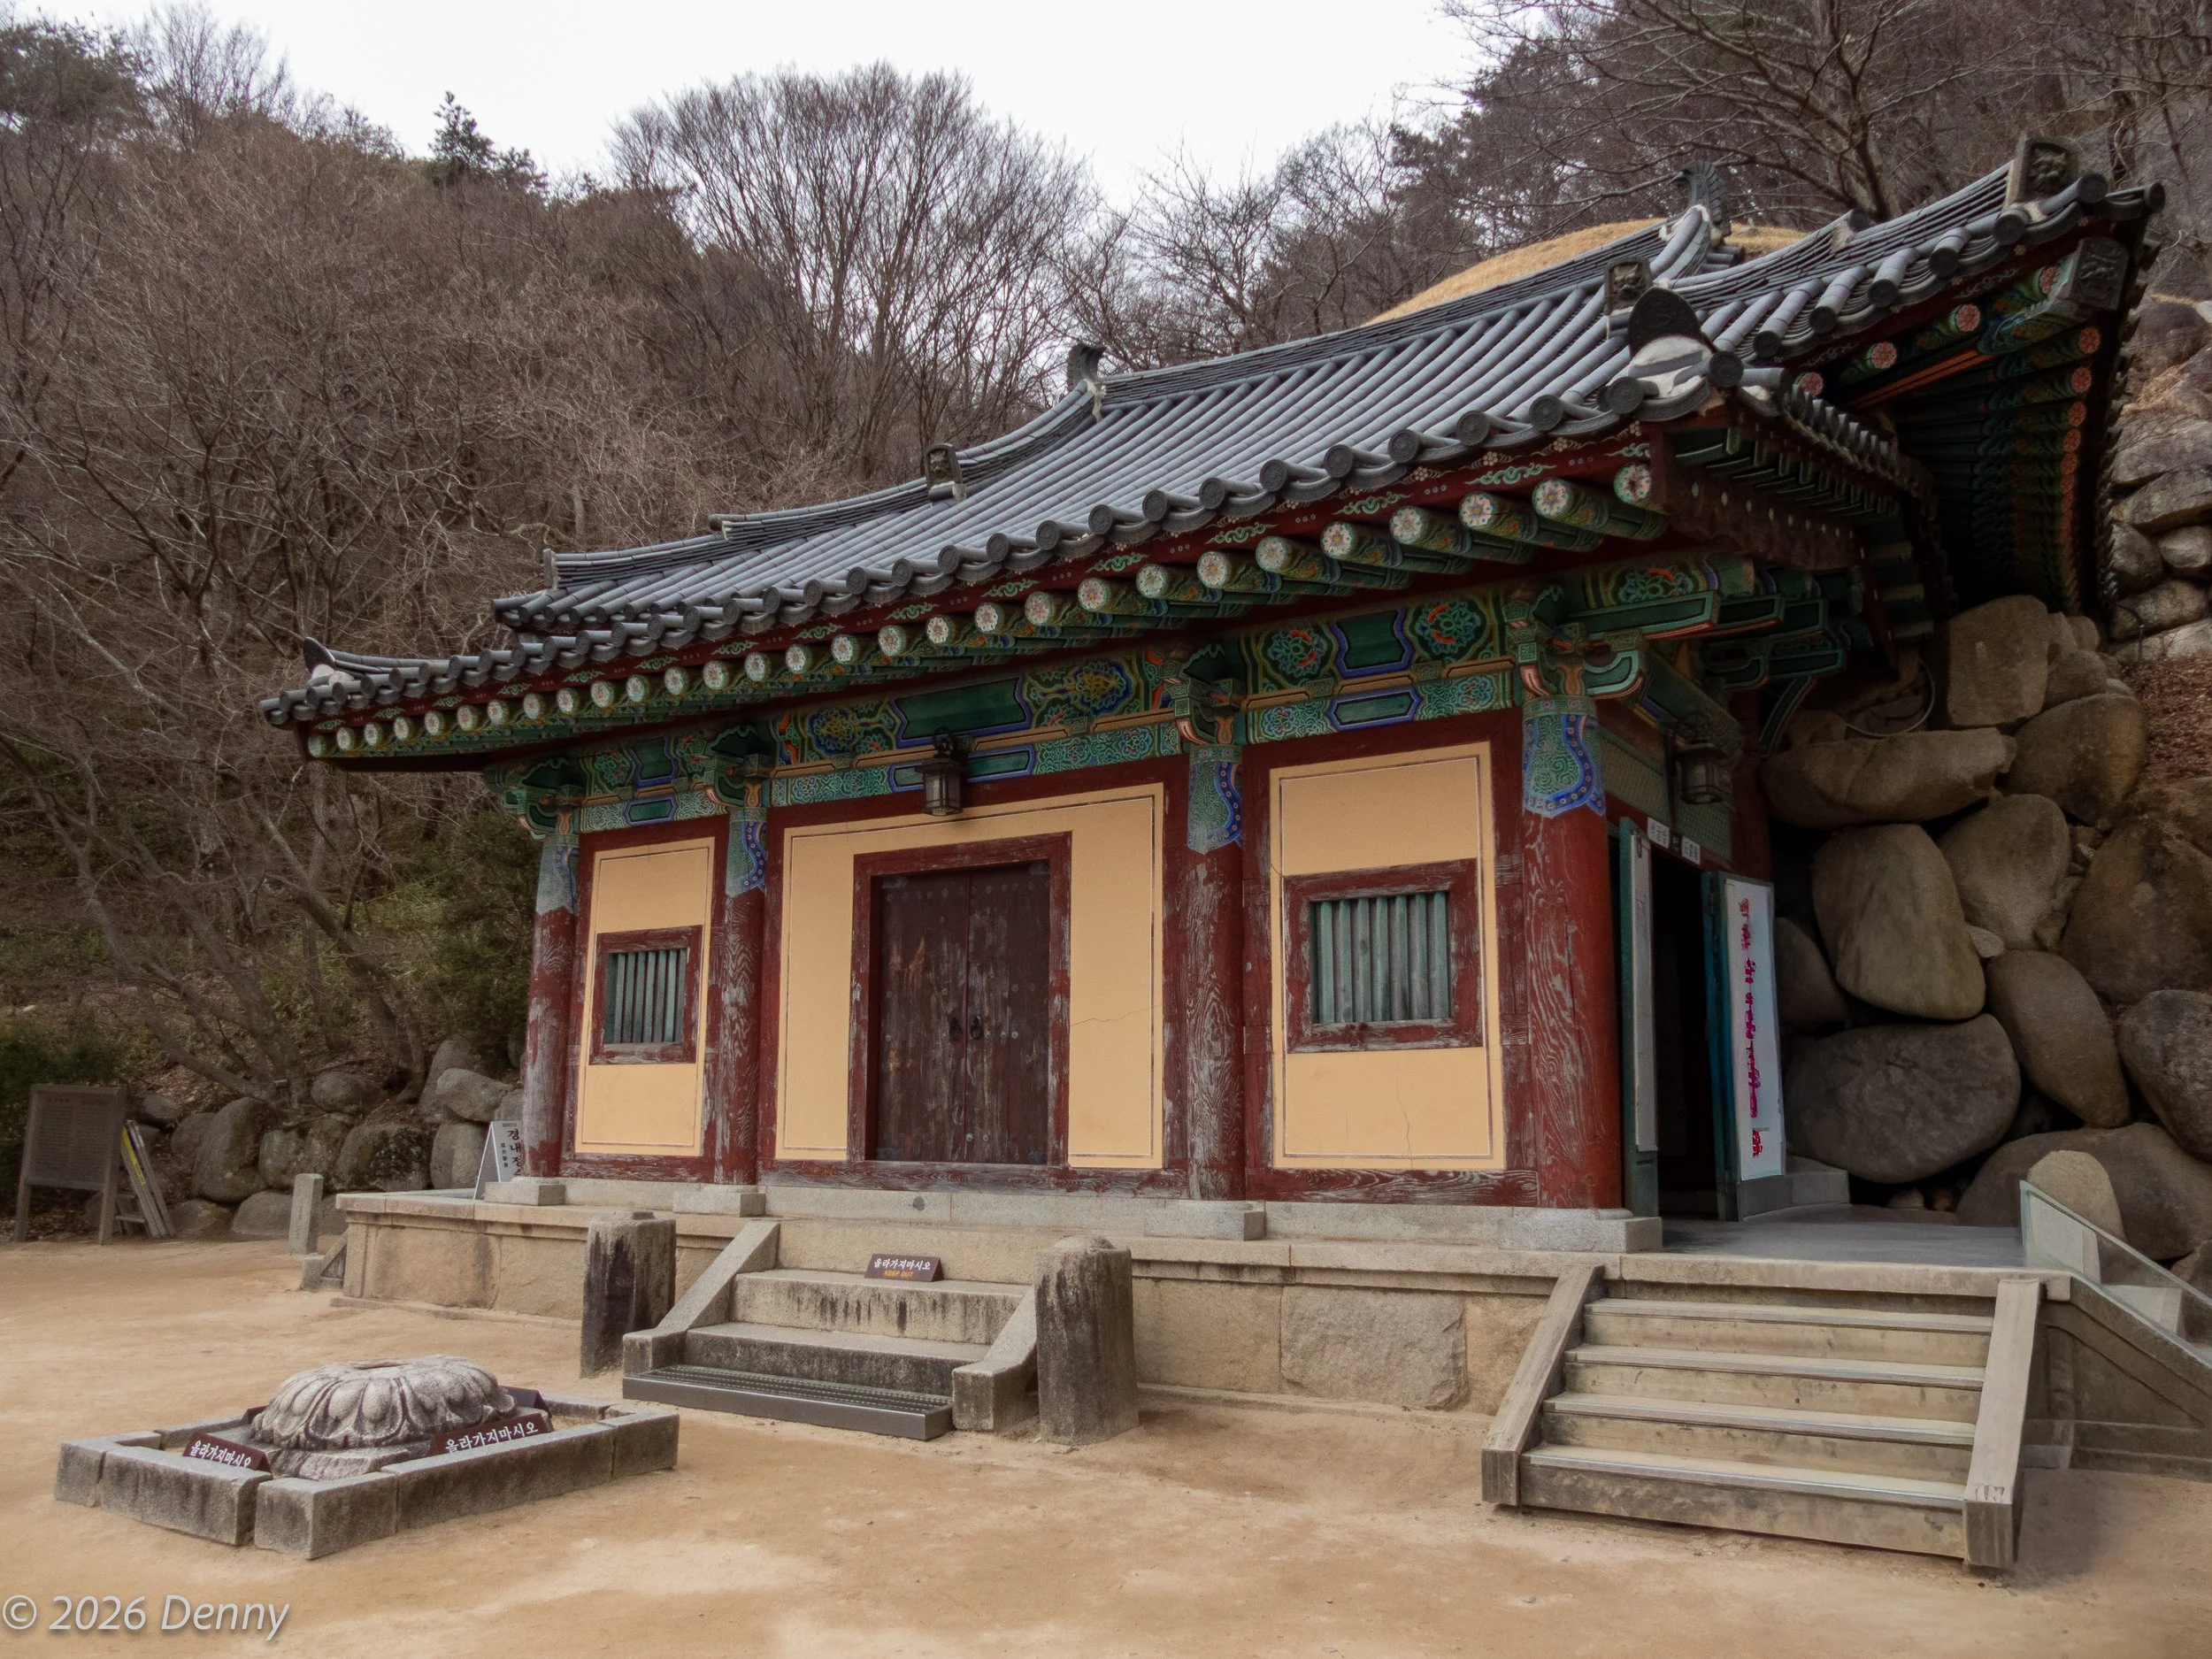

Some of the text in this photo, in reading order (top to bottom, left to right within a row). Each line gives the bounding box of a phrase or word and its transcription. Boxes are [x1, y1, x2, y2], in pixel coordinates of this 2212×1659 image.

[874, 1257, 931, 1271] 올라가지마시오
[445, 1421, 539, 1453] 올라가지마시오
[190, 1440, 252, 1469] 올라가지마시오
